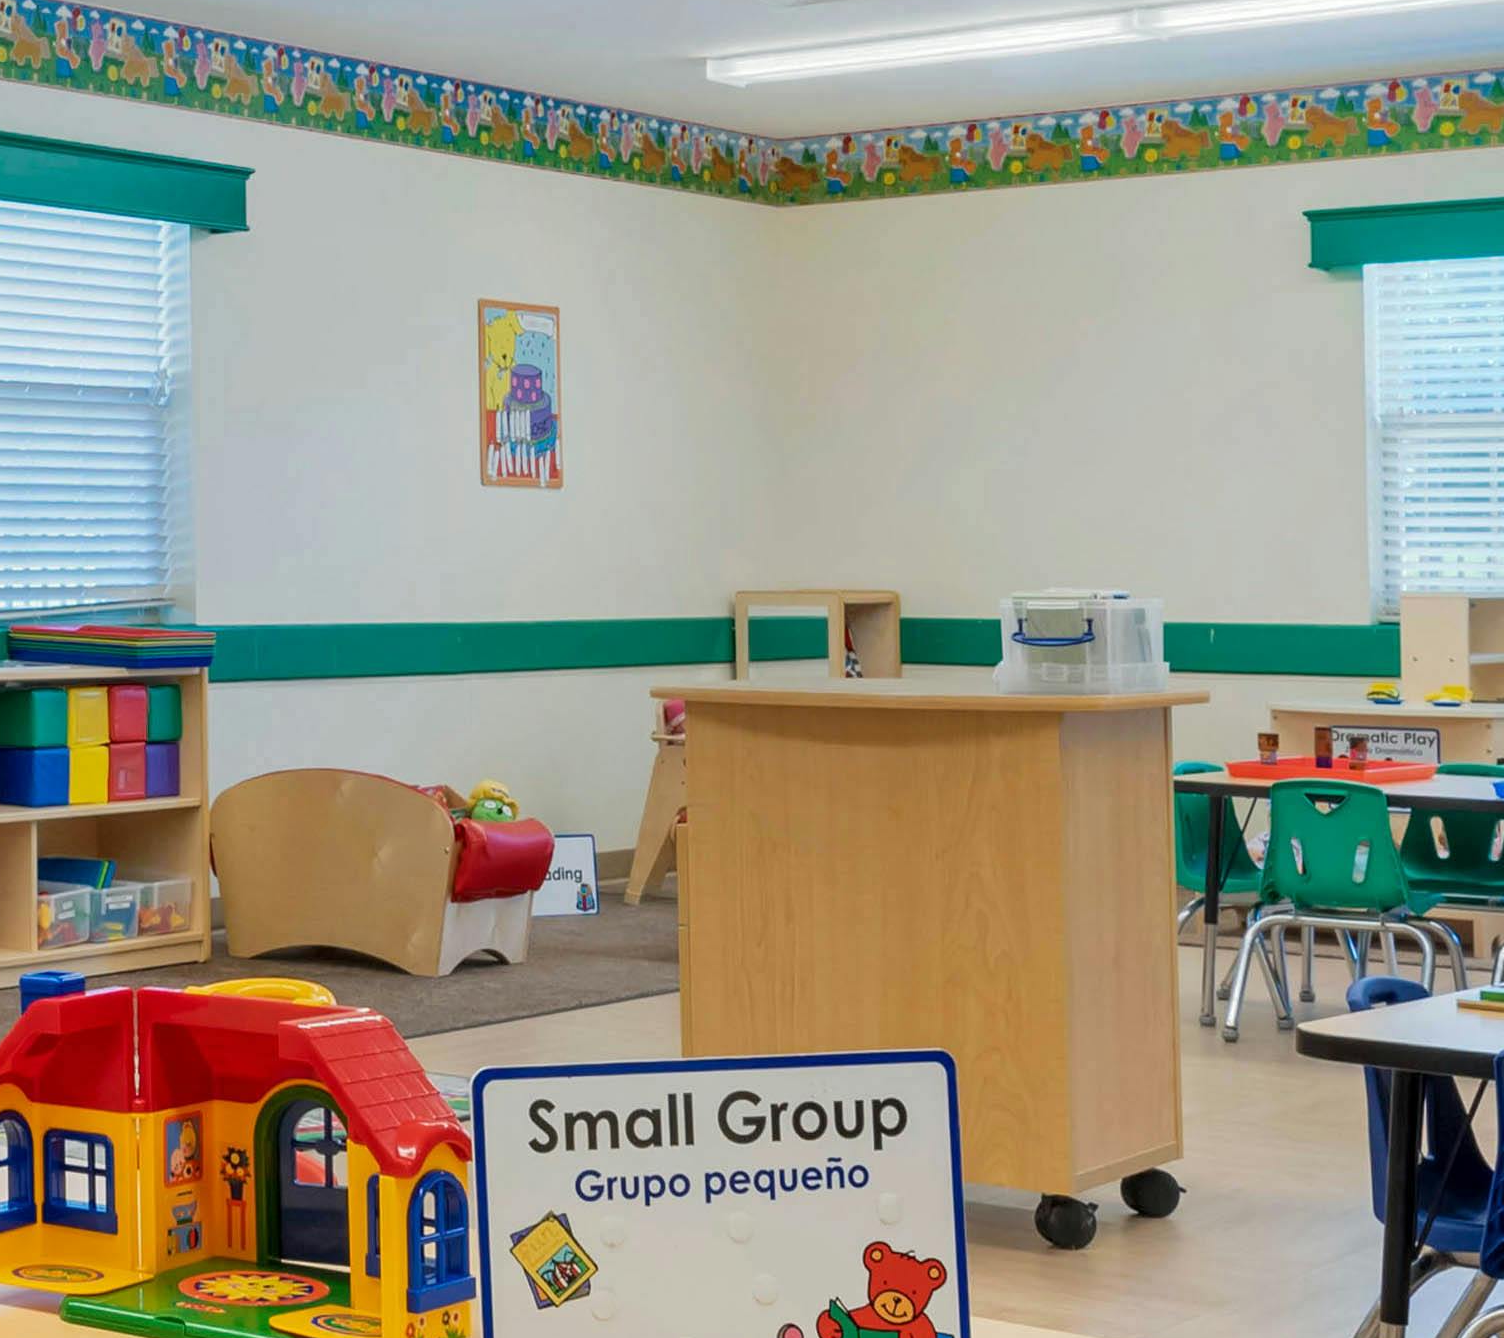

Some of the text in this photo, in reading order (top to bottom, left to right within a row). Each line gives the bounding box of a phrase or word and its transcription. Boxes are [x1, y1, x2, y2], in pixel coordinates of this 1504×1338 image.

[1404, 732, 1436, 748] Play
[544, 867, 582, 883] ading
[528, 1089, 909, 1154] Small Group
[574, 1157, 870, 1207] Grupo pequeño
